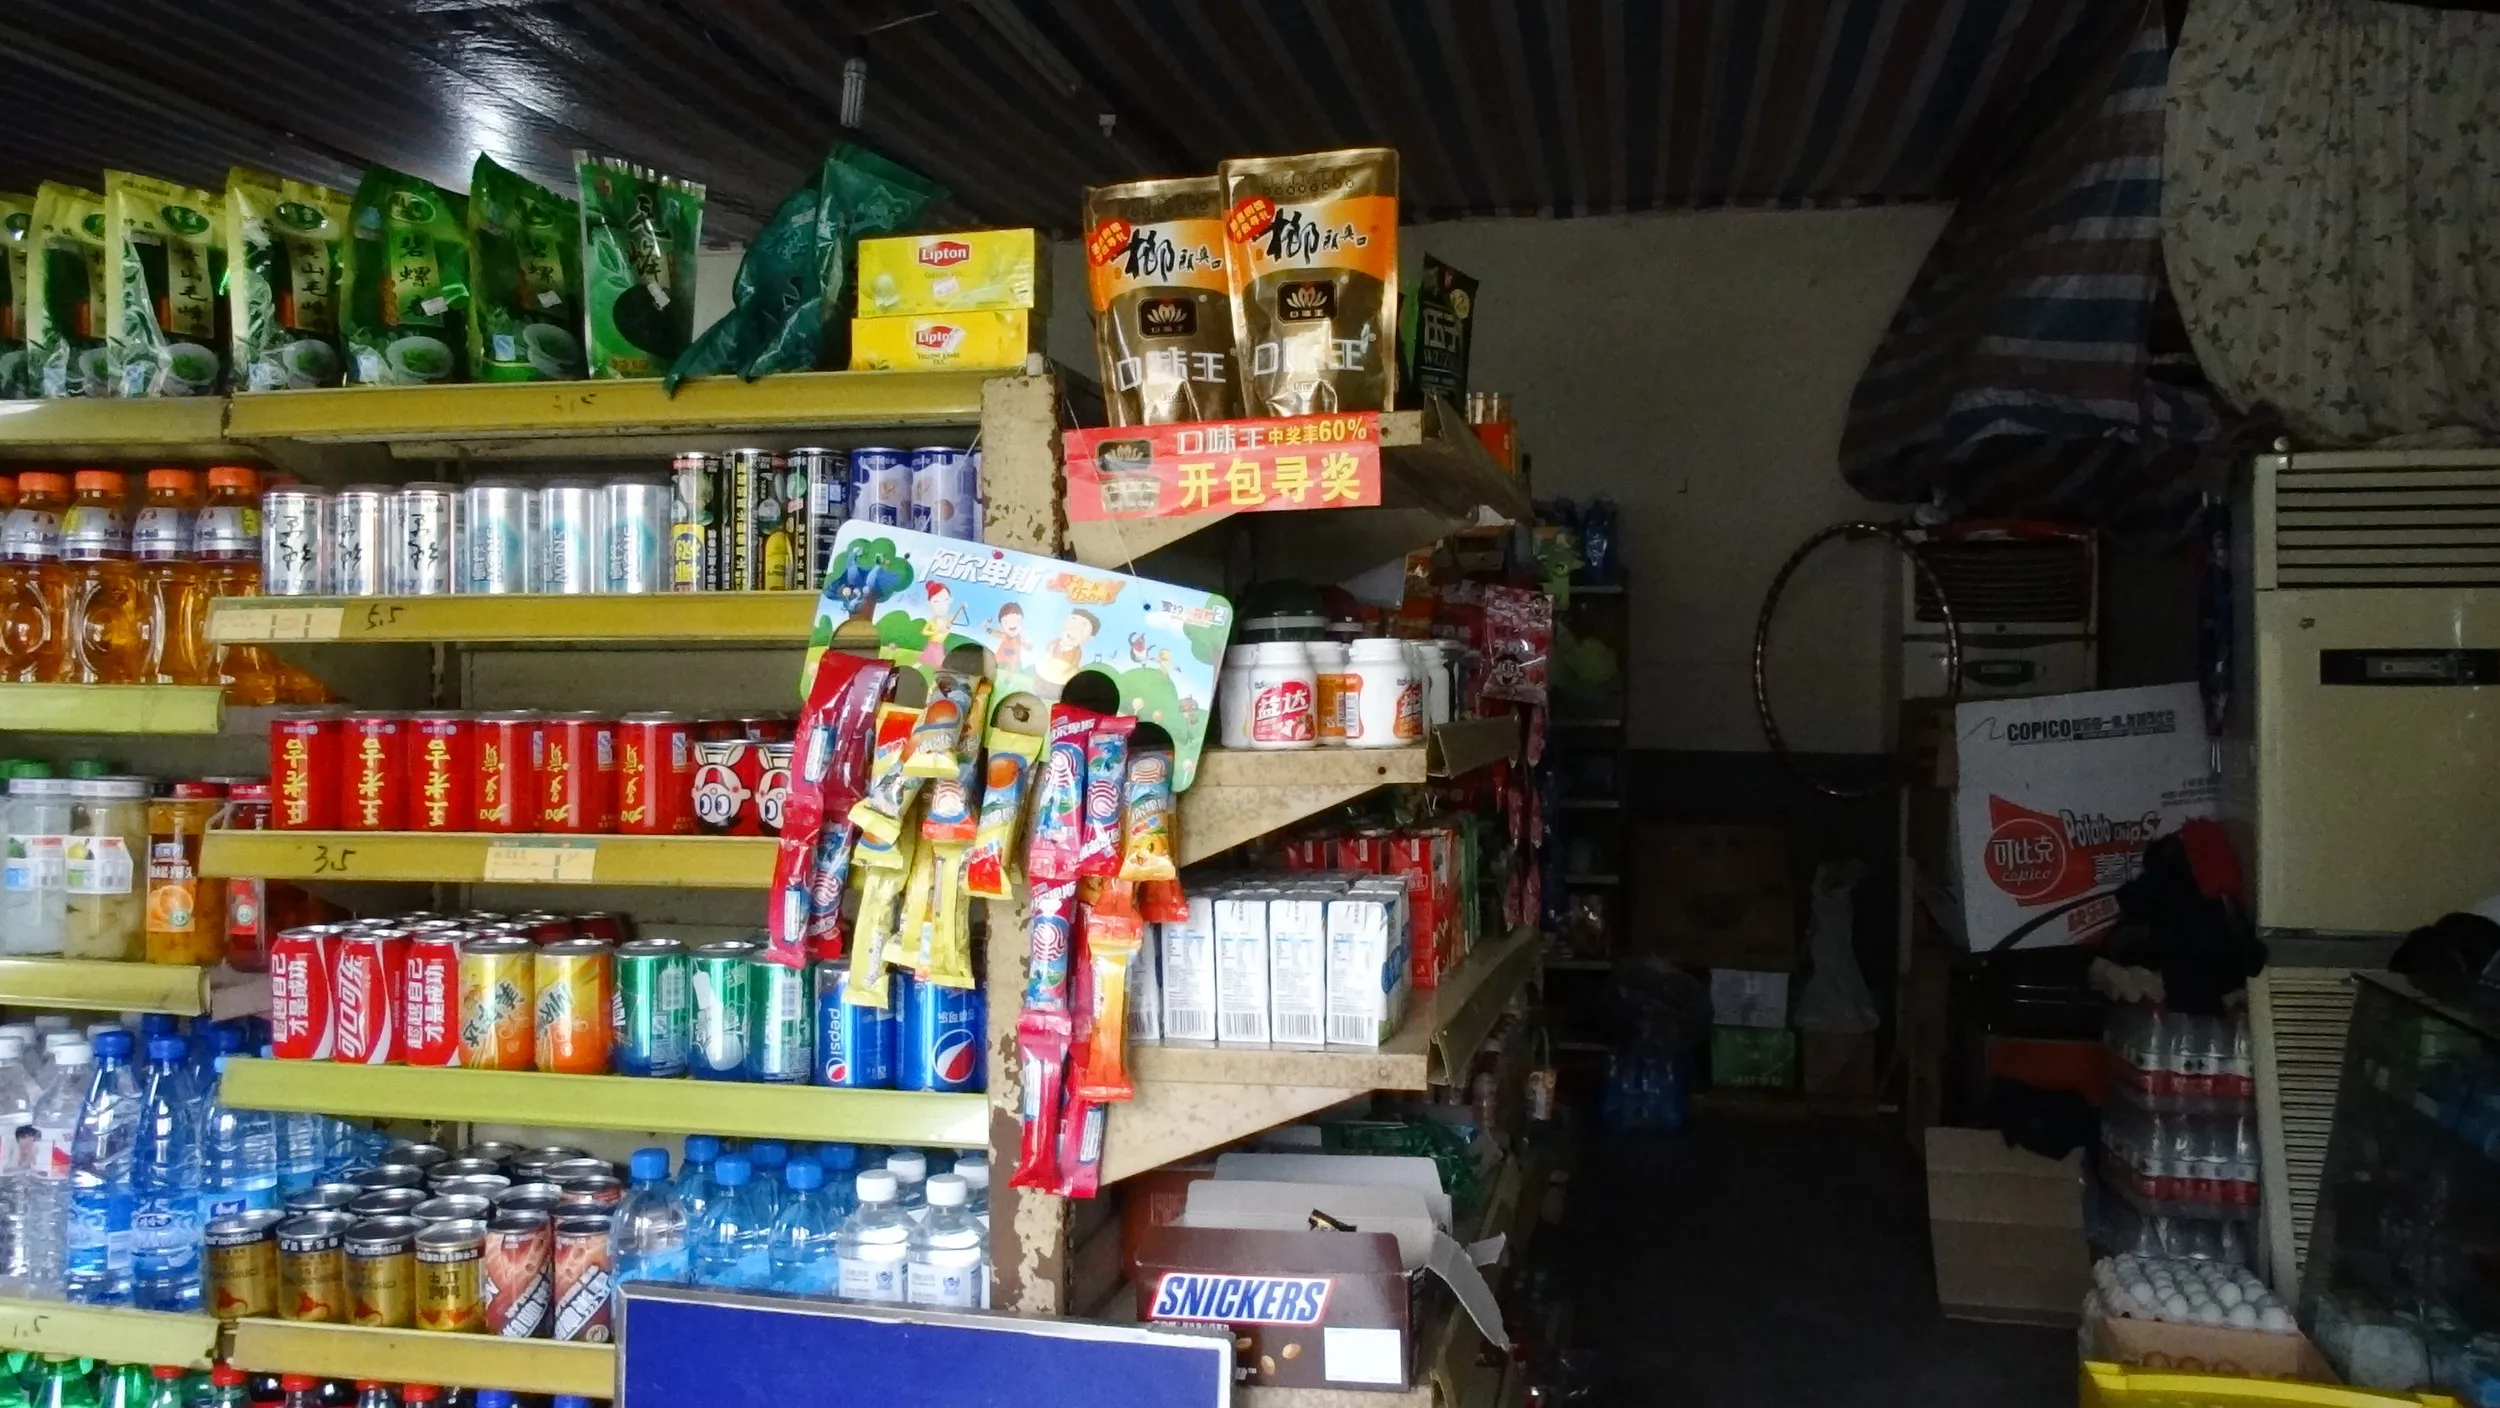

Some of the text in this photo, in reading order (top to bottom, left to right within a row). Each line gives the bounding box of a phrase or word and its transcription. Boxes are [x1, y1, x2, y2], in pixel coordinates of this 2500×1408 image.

[922, 245, 967, 263] Lipton
[918, 330, 955, 346] Lipto
[1253, 337, 1366, 377] 口王
[1177, 416, 1368, 455] 口味王 中奖率60%
[1177, 452, 1361, 508] 开包寻奖
[918, 547, 1047, 595] 阿尔卑斯
[1257, 690, 1309, 721] 益达
[2007, 718, 2072, 742] COPICO
[283, 738, 308, 825] 王老吉
[358, 738, 385, 825] 王老吉
[424, 739, 450, 827] 王老吉
[1993, 836, 2055, 868] 可比克
[272, 953, 288, 1045] 超越自己
[287, 959, 309, 1037] 才是成功
[337, 950, 366, 1058] 可口可乐
[408, 957, 424, 1050] 超越自己
[425, 964, 446, 1043] 才是成功
[829, 1008, 842, 1056] pepsi
[1158, 1275, 1327, 1322] SNICKERS
